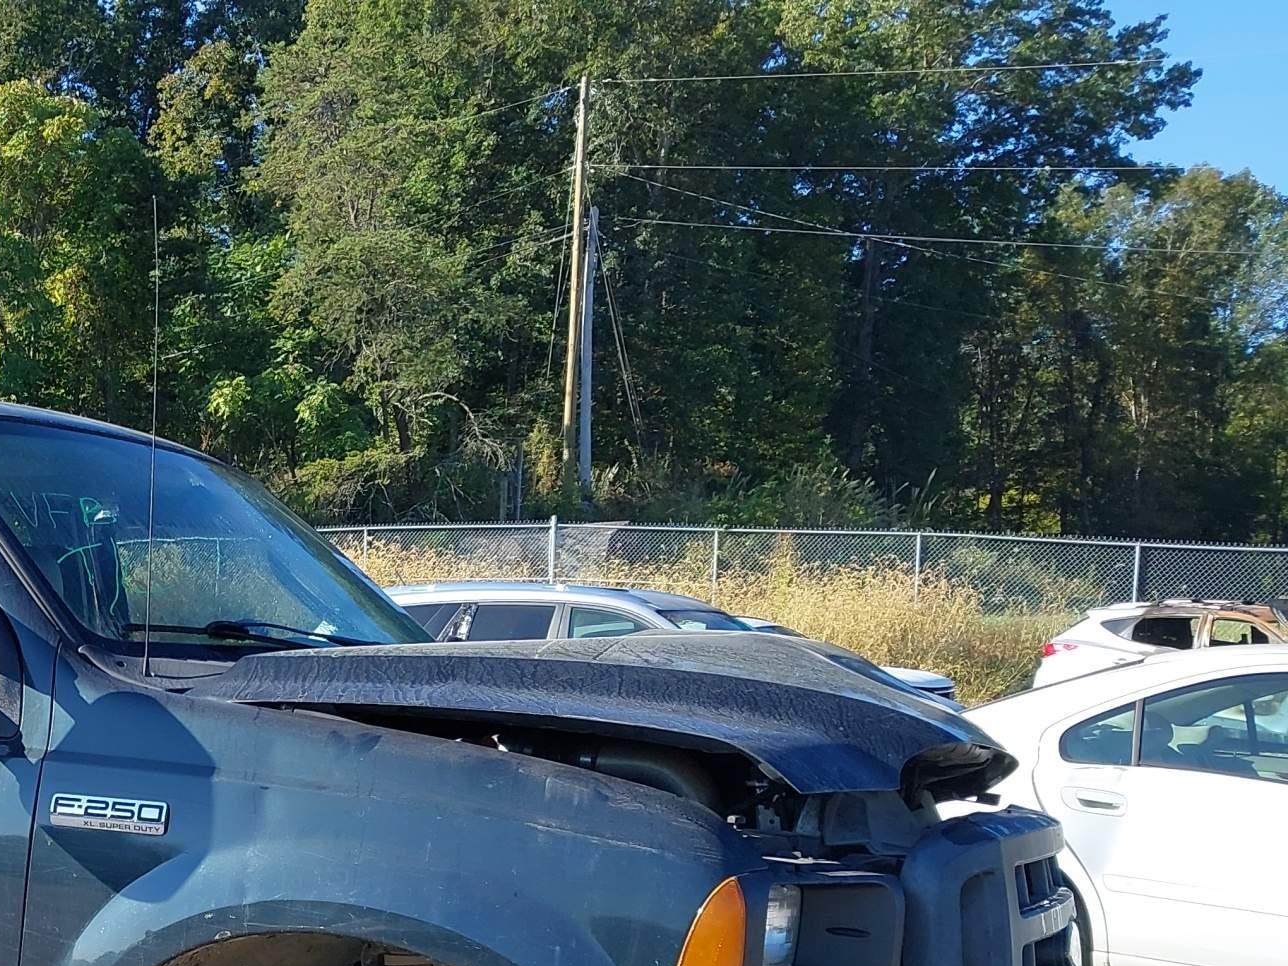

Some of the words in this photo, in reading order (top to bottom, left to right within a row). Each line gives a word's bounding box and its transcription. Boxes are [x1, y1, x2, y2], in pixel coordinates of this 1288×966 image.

[53, 797, 164, 822] F-250
[99, 821, 131, 831] SUPER
[133, 824, 161, 833] DUTY
